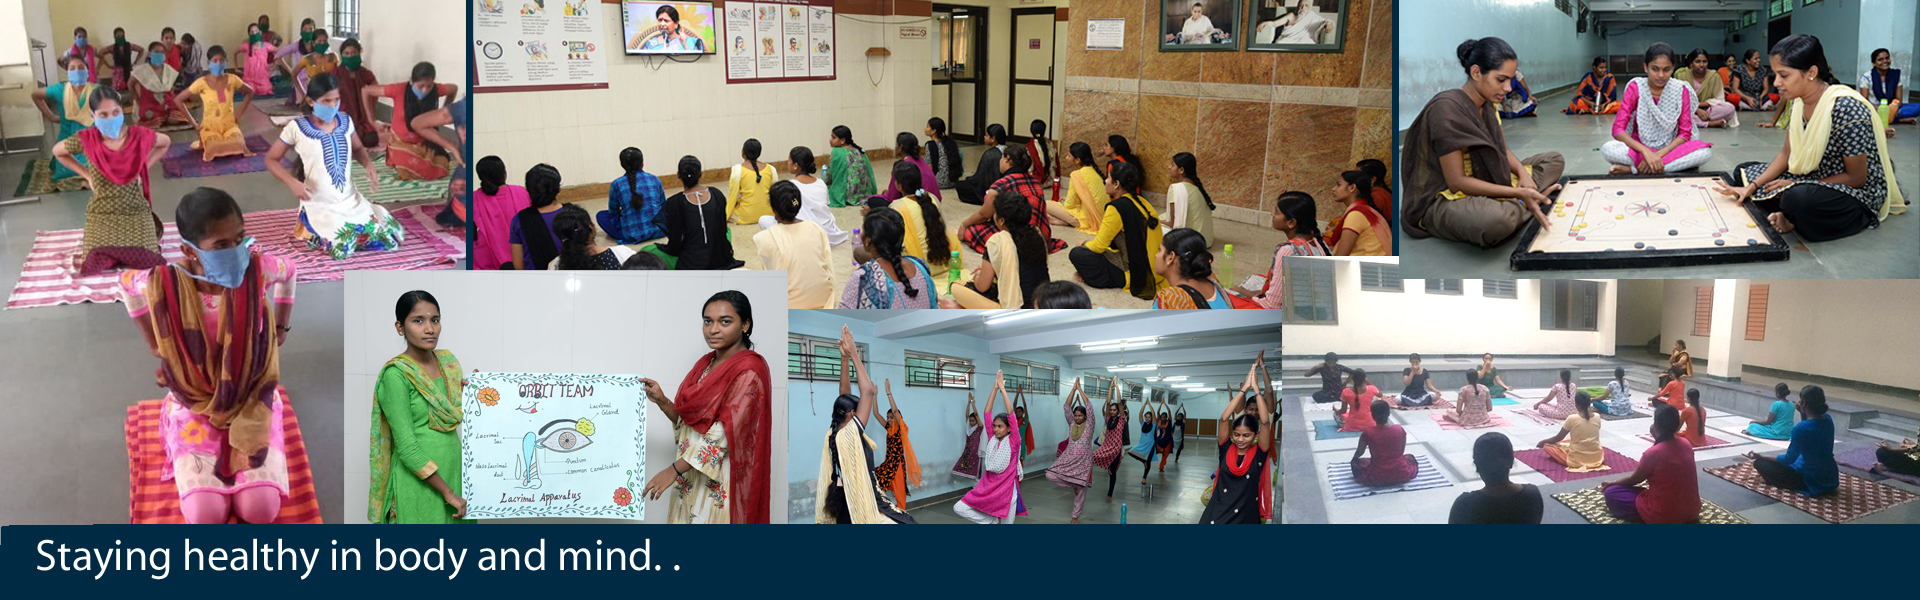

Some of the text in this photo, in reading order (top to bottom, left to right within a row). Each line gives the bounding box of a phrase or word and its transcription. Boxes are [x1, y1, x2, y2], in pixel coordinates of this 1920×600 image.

[519, 383, 594, 399] ORBIT TEAM
[601, 408, 619, 416] Gland
[475, 431, 499, 439] Lacrimal
[500, 489, 581, 506] Lacrimal Apparatus
